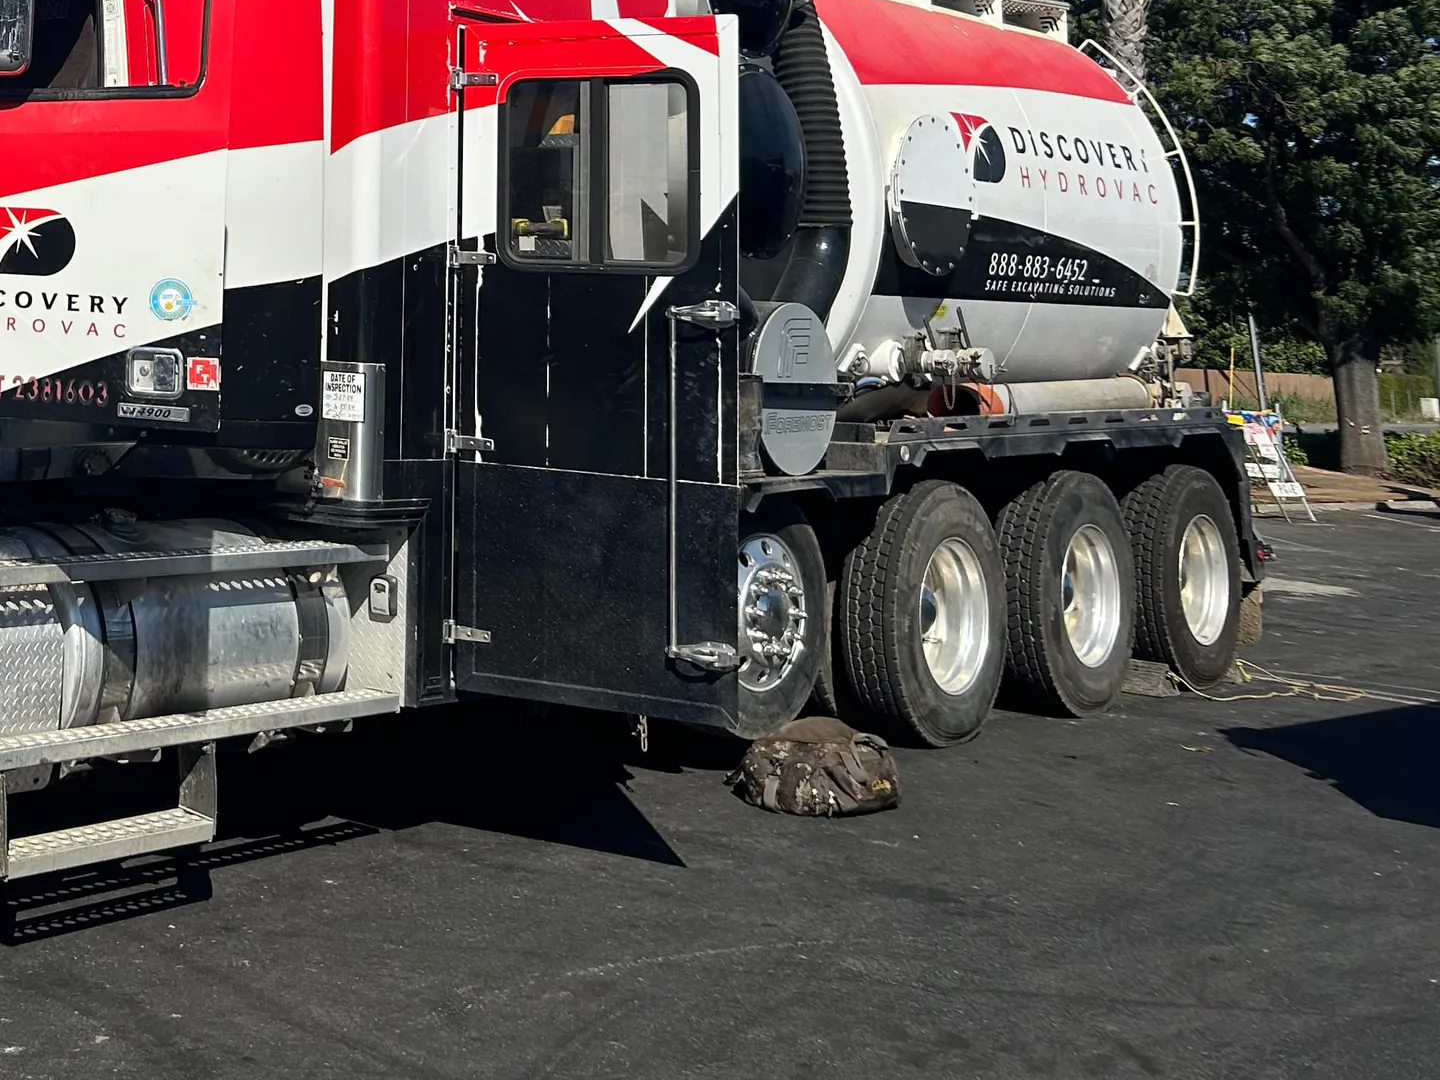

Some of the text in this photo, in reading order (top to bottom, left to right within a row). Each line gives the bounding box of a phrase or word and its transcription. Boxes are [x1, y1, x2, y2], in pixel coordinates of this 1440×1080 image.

[1019, 166, 1158, 204] HYDROVAC
[984, 279, 1117, 297] SAFE EXCAVATING SOLUTIONS
[330, 373, 356, 384] DATE OF
[12, 374, 110, 407] 2381603
[325, 382, 362, 394] INSPECTION
[136, 407, 172, 419] 4900
[764, 411, 834, 435] FOREMOST
